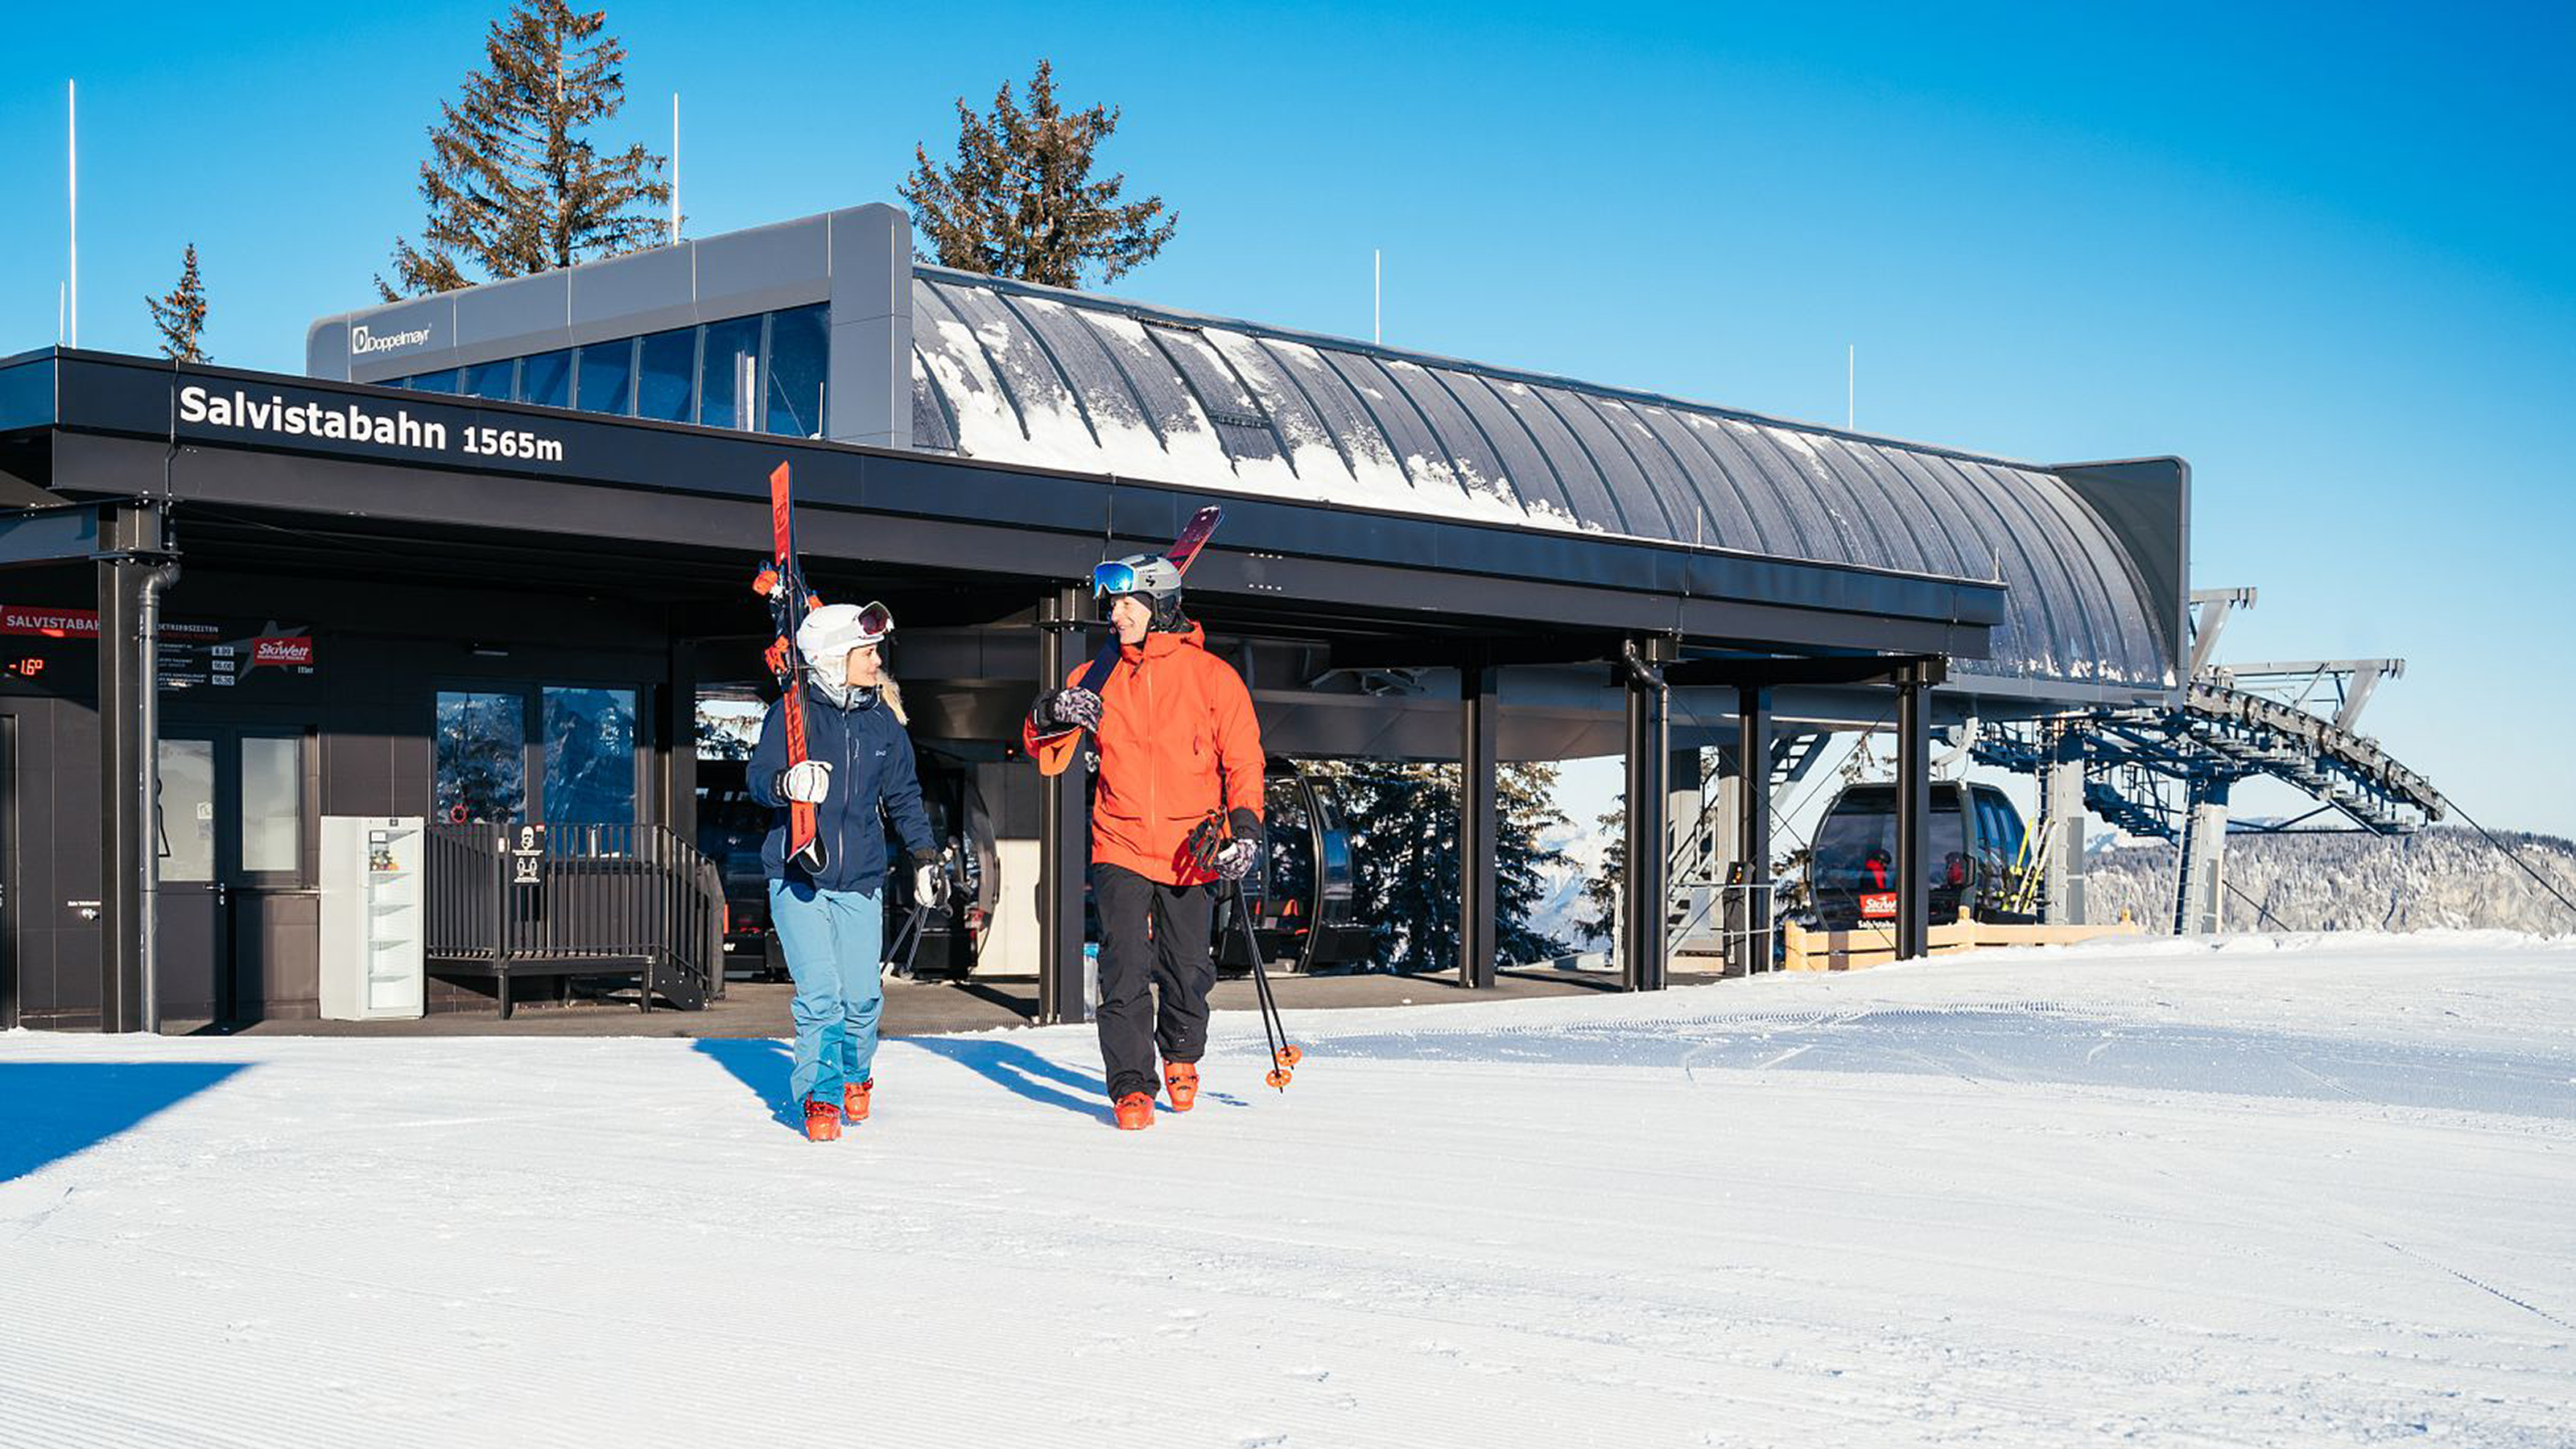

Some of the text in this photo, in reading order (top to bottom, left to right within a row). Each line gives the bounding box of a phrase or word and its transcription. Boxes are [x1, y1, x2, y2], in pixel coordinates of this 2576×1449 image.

[368, 329, 430, 353] Doppelmayr
[180, 387, 563, 460] Salvistabahn 1565m
[6, 615, 101, 630] SALVISTABAH
[1866, 898, 1897, 910] SkiW
